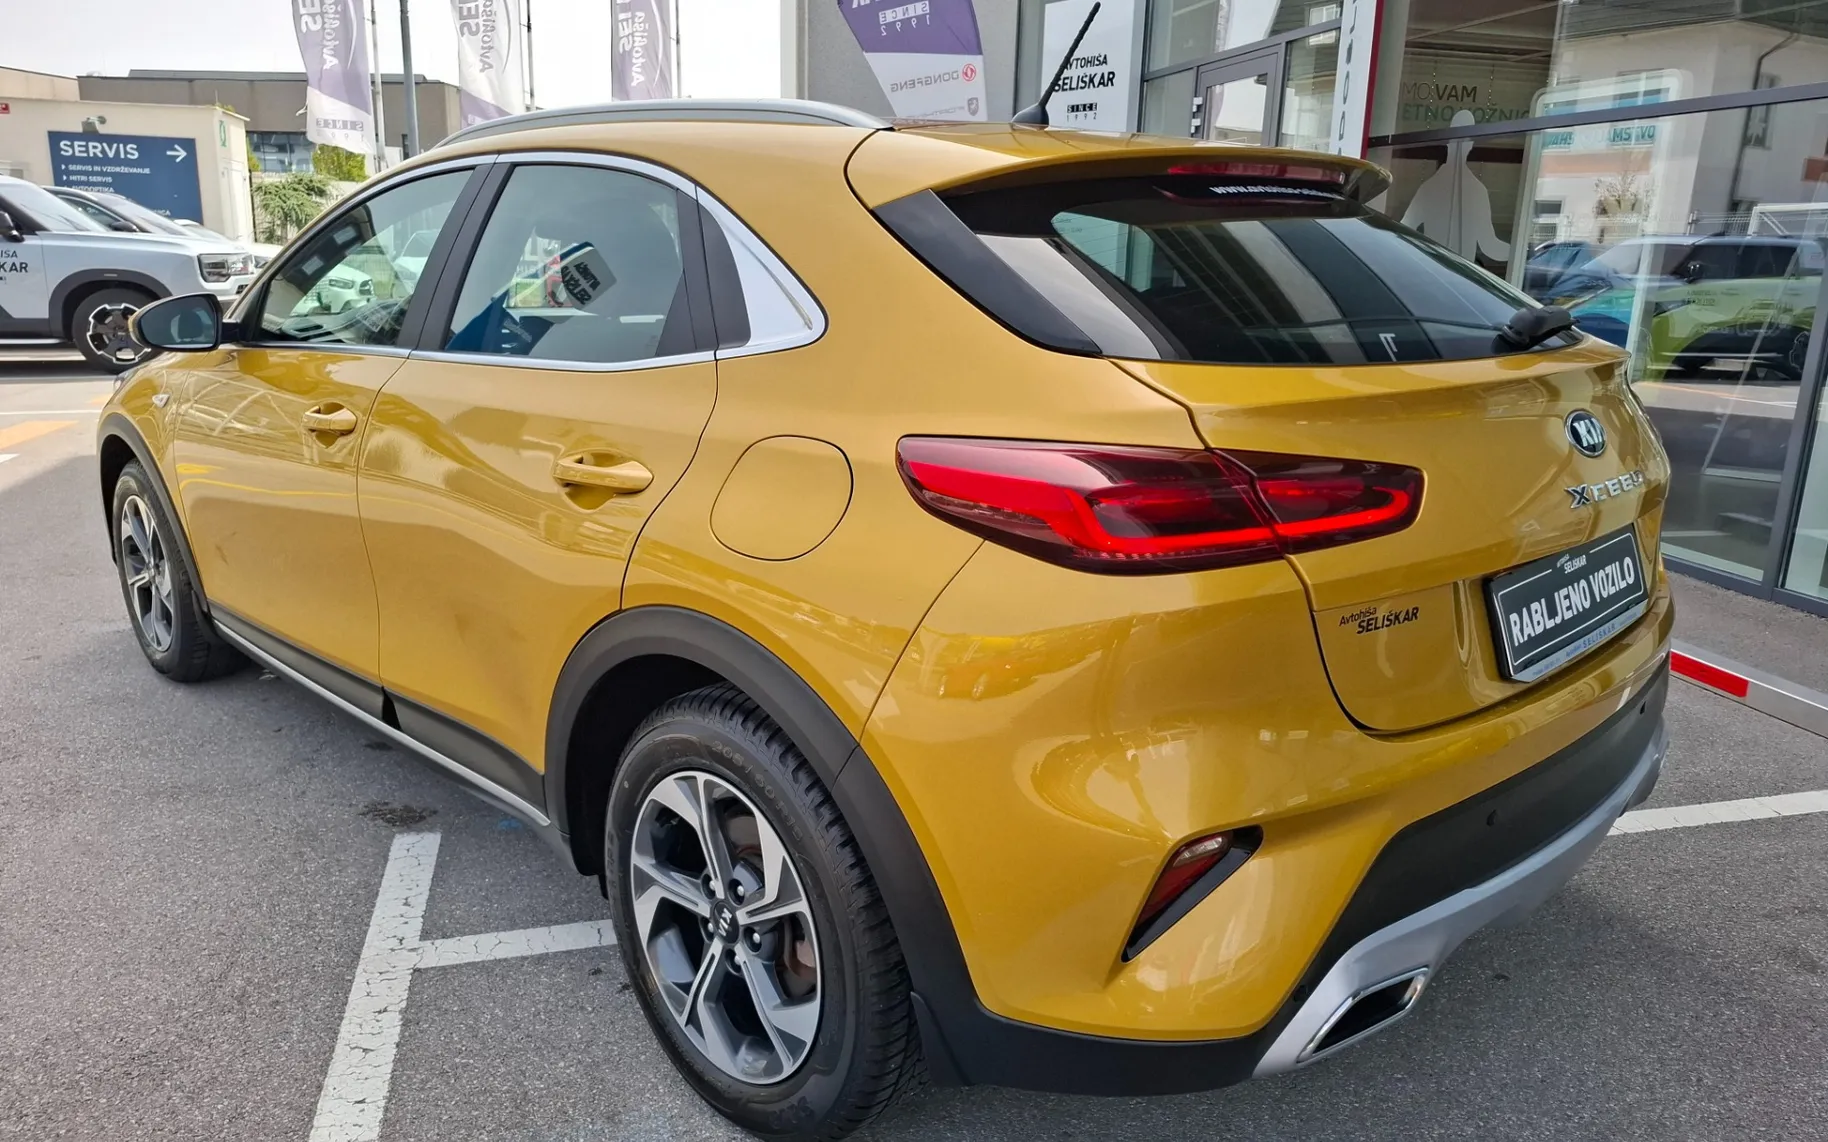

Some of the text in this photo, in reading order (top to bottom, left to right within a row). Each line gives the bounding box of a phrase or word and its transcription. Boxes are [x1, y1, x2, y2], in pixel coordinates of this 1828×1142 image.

[1435, 84, 1478, 102] VAM
[1067, 103, 1098, 113] SINCE
[59, 140, 139, 159] SERVIS
[102, 166, 151, 174] VZDRŽEVANJE
[1564, 469, 1643, 509] XCEED
[1509, 556, 1636, 647] RABLJENO VOZILO
[1339, 606, 1377, 627] Avtohiša
[1356, 606, 1420, 635] SELIŠKAR
